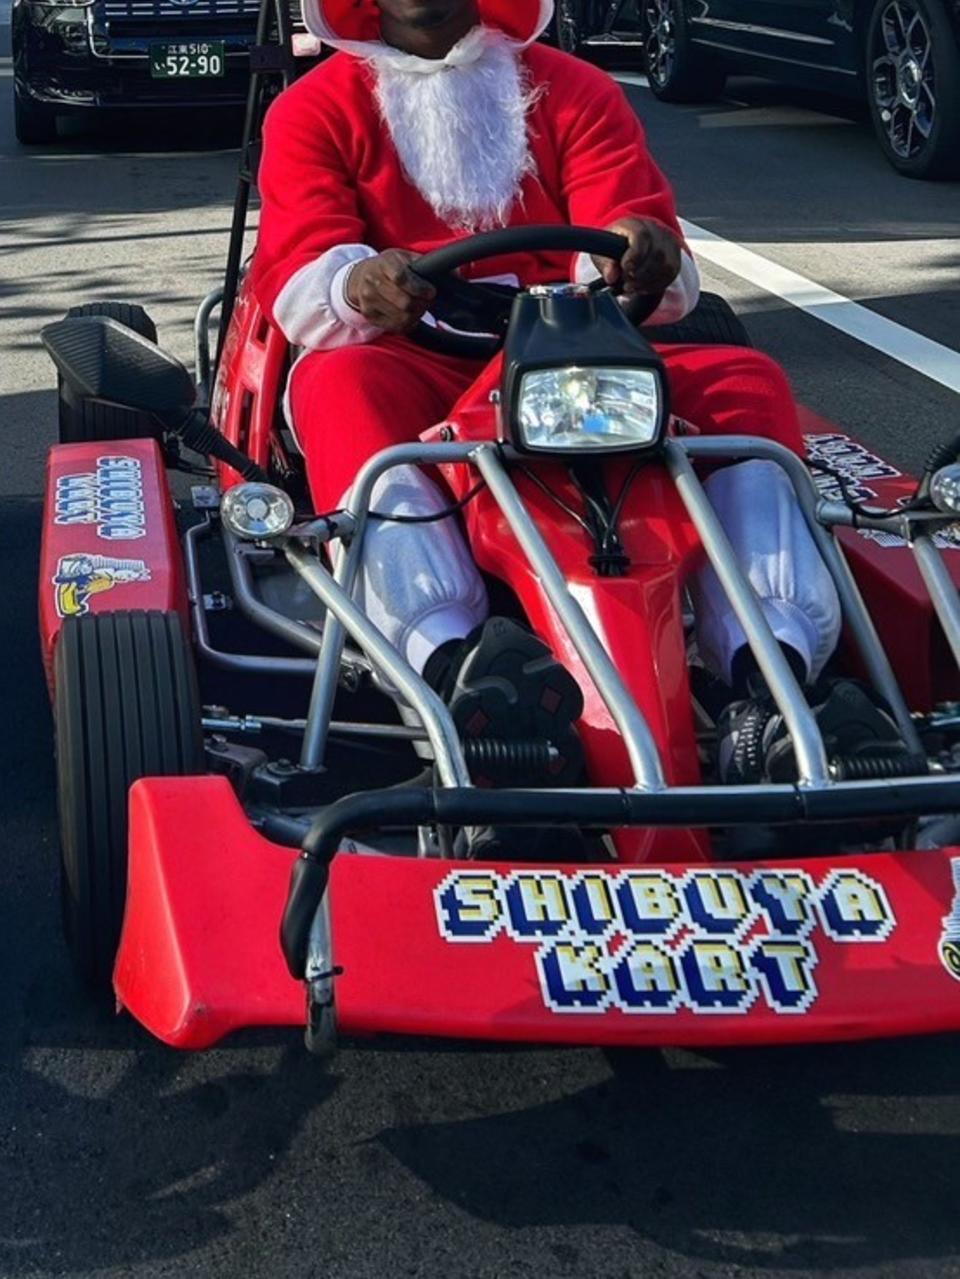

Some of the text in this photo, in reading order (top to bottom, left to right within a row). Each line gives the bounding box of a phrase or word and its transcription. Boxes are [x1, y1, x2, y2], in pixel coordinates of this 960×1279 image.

[54, 473, 99, 525] KART
[96, 455, 146, 540] SHIBUYA
[433, 869, 897, 942] SHIBUYA
[534, 937, 819, 1014] KART
